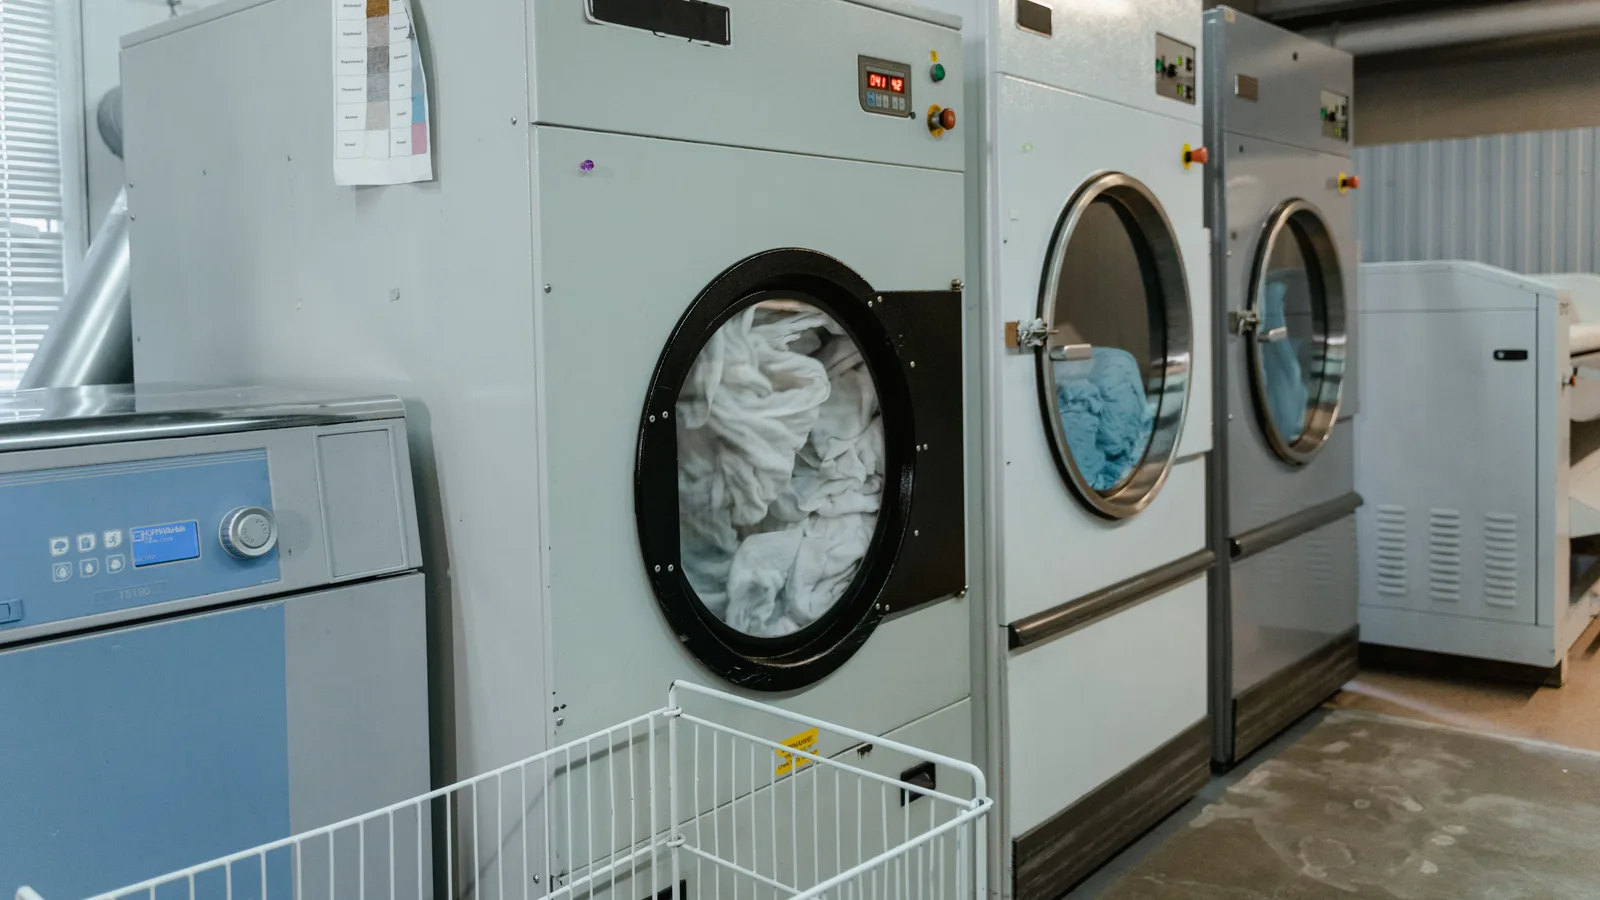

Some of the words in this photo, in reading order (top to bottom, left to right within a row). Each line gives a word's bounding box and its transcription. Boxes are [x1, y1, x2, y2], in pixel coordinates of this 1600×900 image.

[869, 74, 886, 88] 041
[891, 79, 902, 91] 42
[118, 586, 151, 599] T5190
